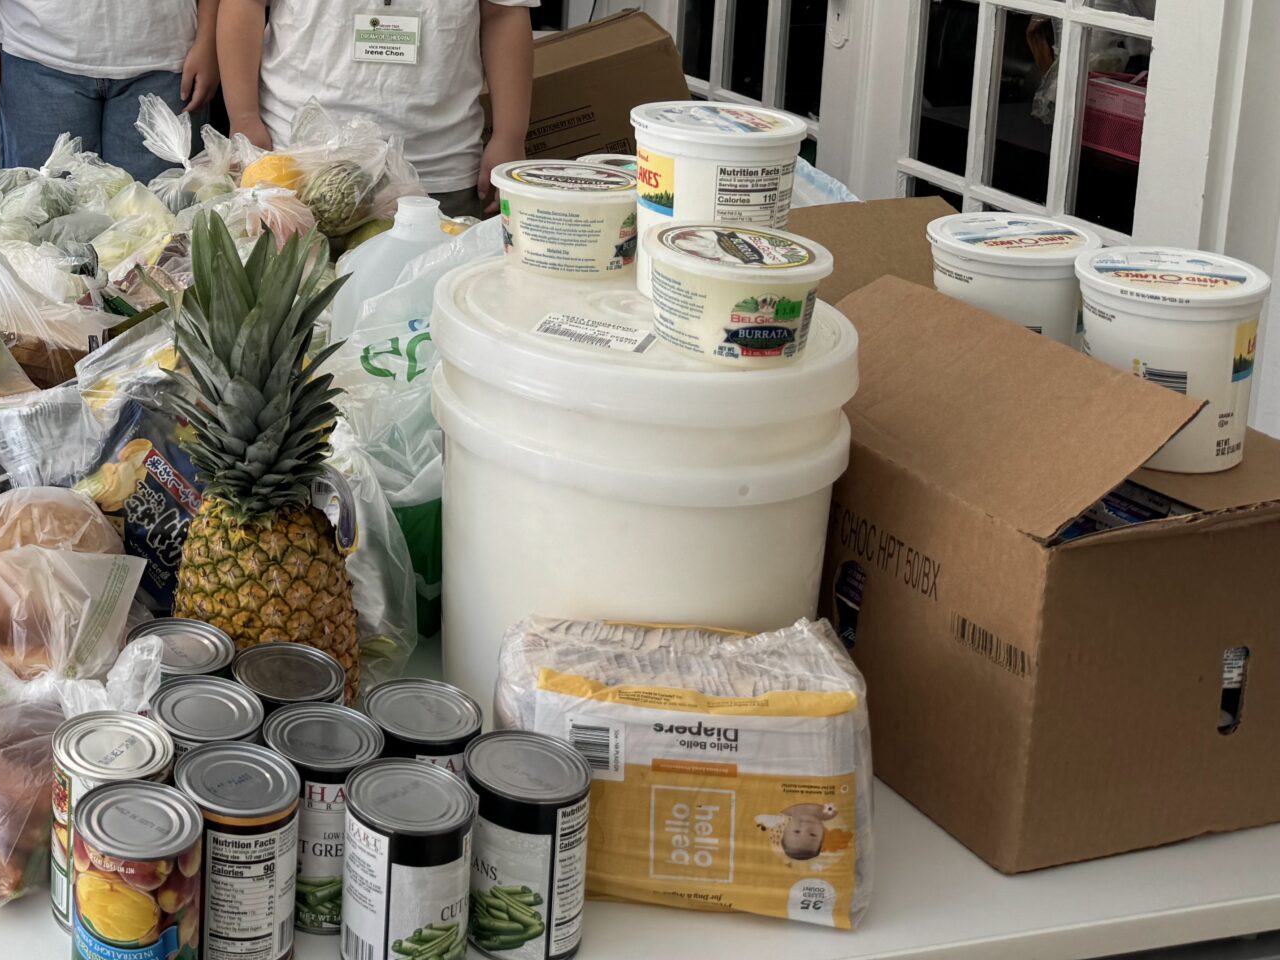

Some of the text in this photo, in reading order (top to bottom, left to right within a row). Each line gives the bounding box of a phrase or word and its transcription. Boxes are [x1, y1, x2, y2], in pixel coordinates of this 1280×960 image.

[719, 167, 780, 177] Nutrition Facts
[717, 193, 777, 204] Calories 110
[1113, 271, 1157, 280] LAKES
[1185, 276, 1229, 285] LAND
[738, 328, 789, 339] BURRATA
[840, 509, 876, 562] CHOC
[876, 530, 905, 578] HPT
[904, 547, 941, 602] 50/BX
[653, 721, 739, 743] Diapers
[709, 742, 739, 752] Hello
[323, 831, 341, 840] LOW
[665, 803, 690, 866] bello
[693, 803, 720, 867] hello
[212, 836, 276, 849] Nutrition Facts
[211, 850, 229, 859] Serving
[125, 866, 135, 874] NET
[211, 865, 244, 877] Calories
[263, 862, 275, 874] 90
[800, 899, 823, 910] 35
[440, 902, 463, 921] CUT
